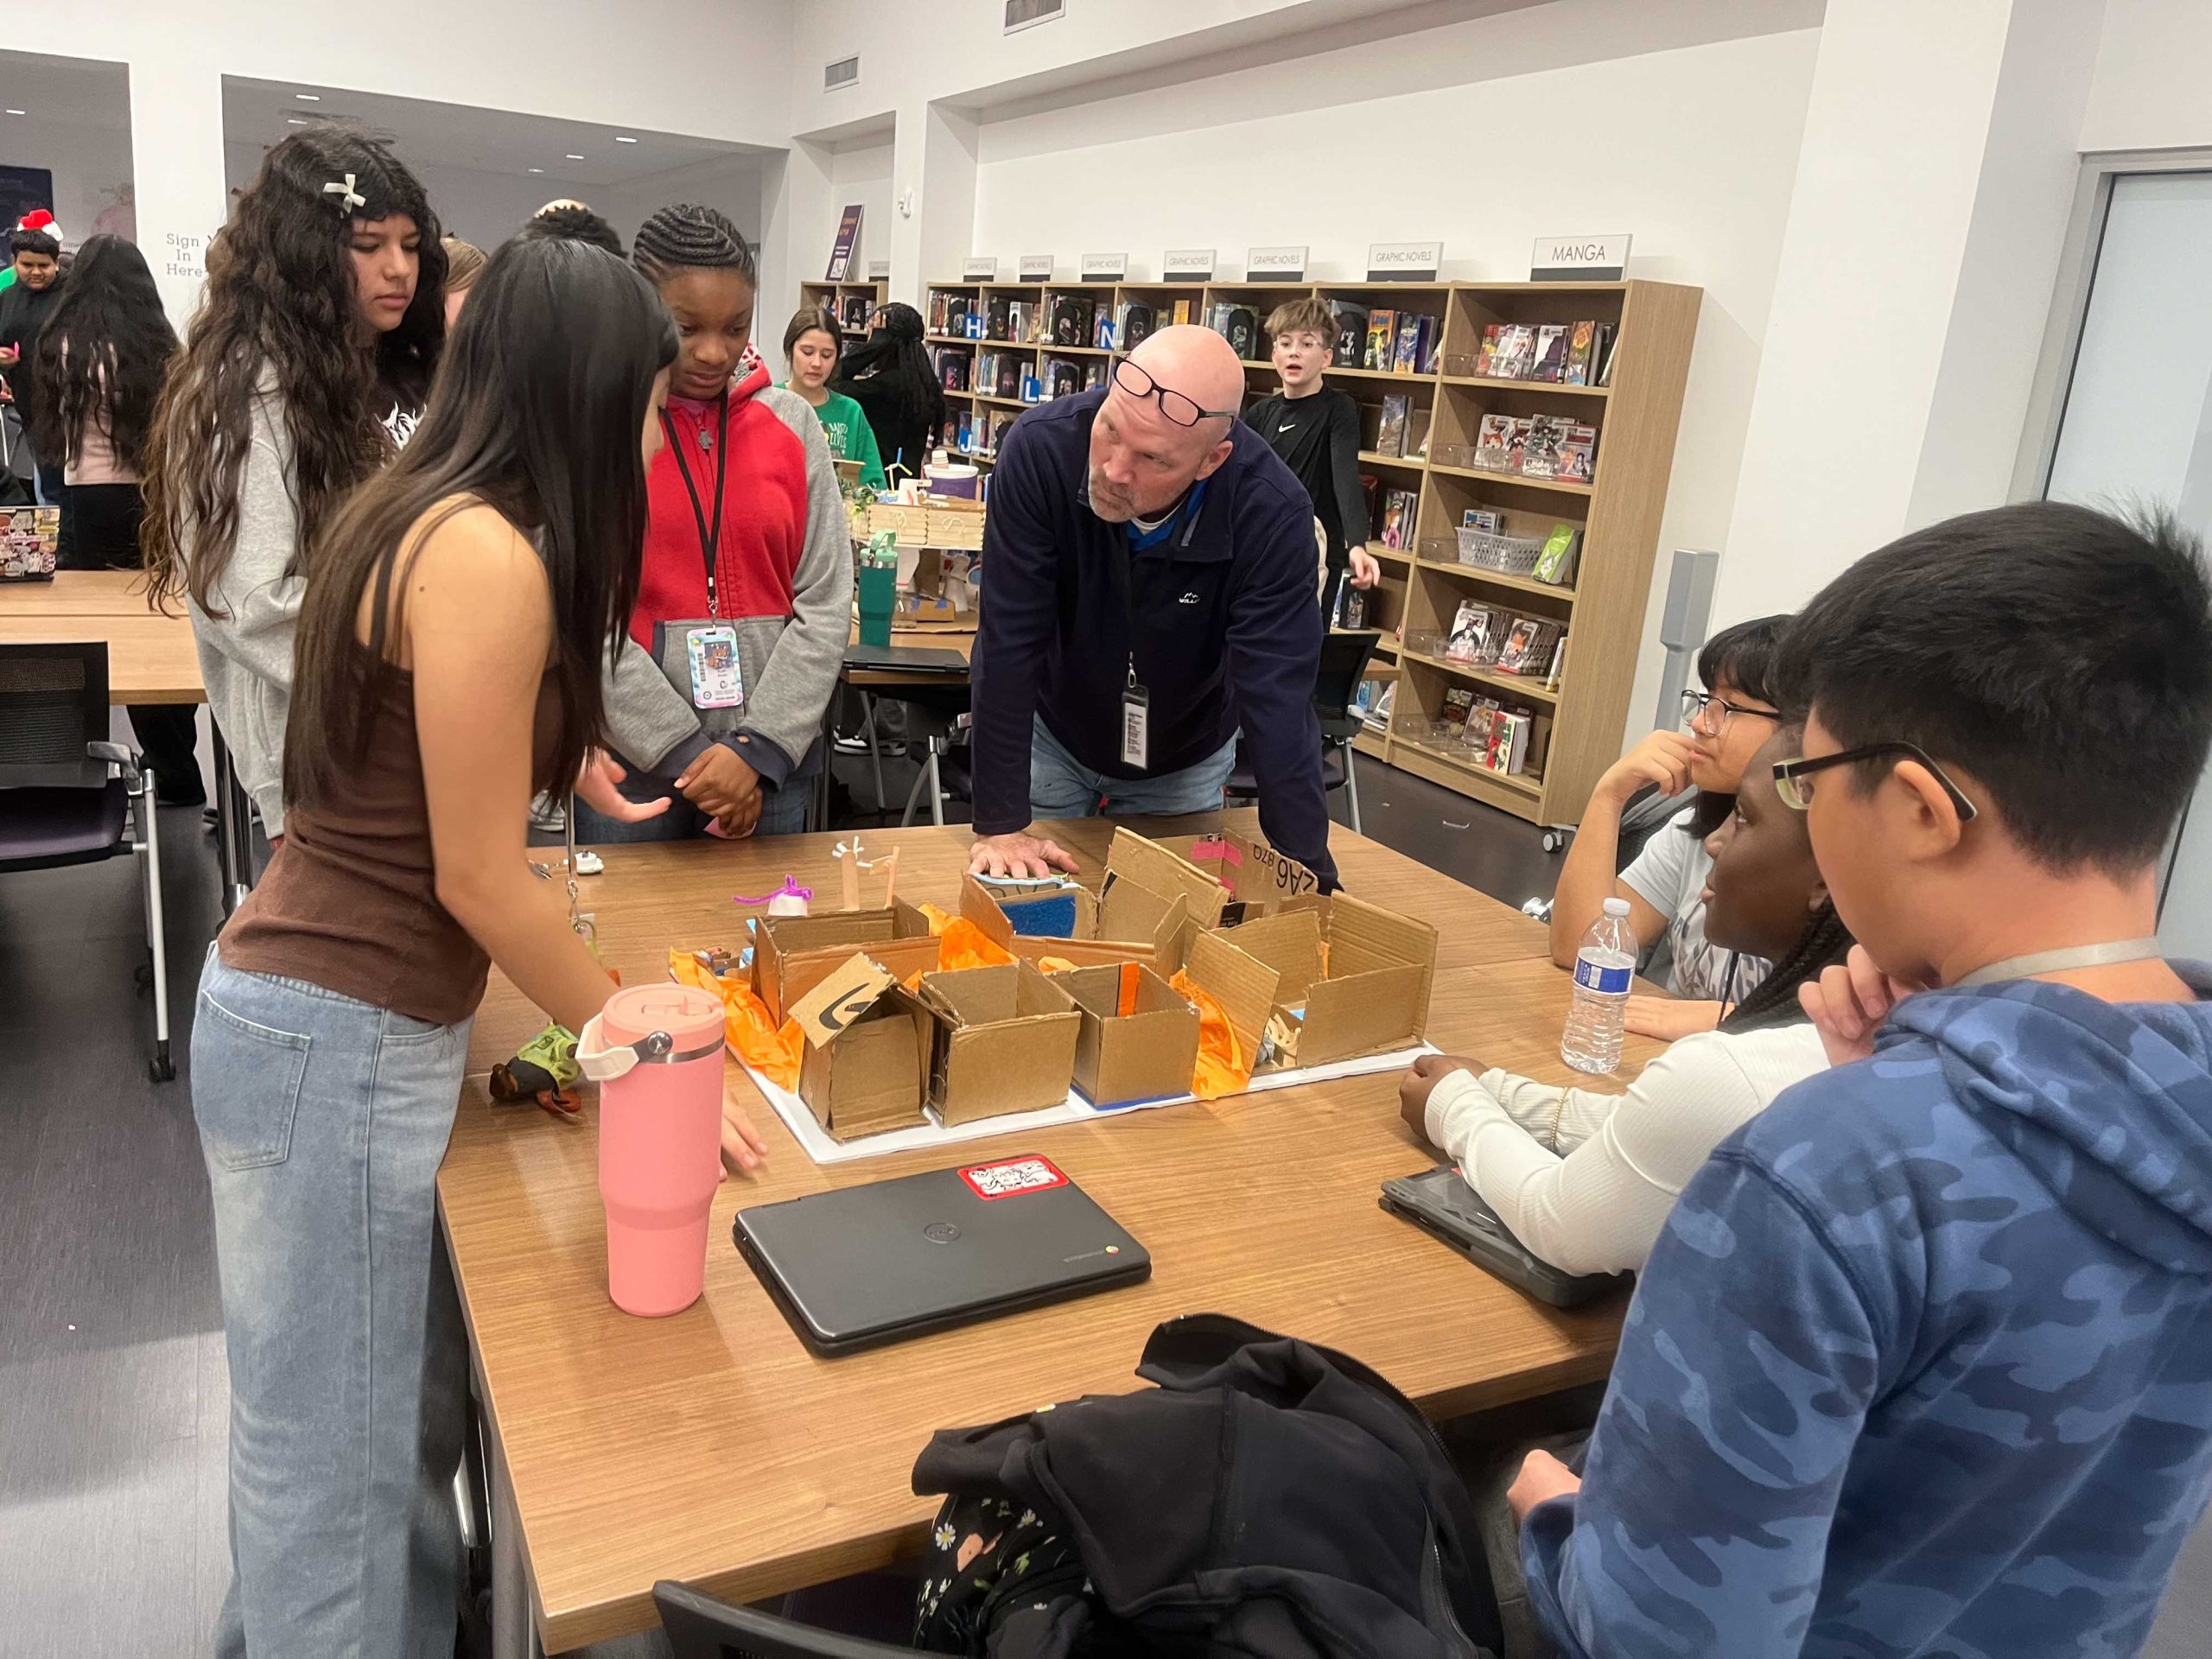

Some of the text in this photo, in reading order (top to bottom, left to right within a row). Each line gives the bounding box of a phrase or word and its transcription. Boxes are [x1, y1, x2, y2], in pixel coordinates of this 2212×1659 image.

[166, 232, 199, 249] Sign
[176, 249, 191, 261] In
[1376, 251, 1432, 262] GRAPHIC NOVELS
[1552, 244, 1605, 261] MANGA
[167, 263, 202, 276] Here
[966, 318, 981, 338] H
[1101, 325, 1116, 348] N
[1026, 380, 1037, 402] L
[960, 433, 972, 453] J
